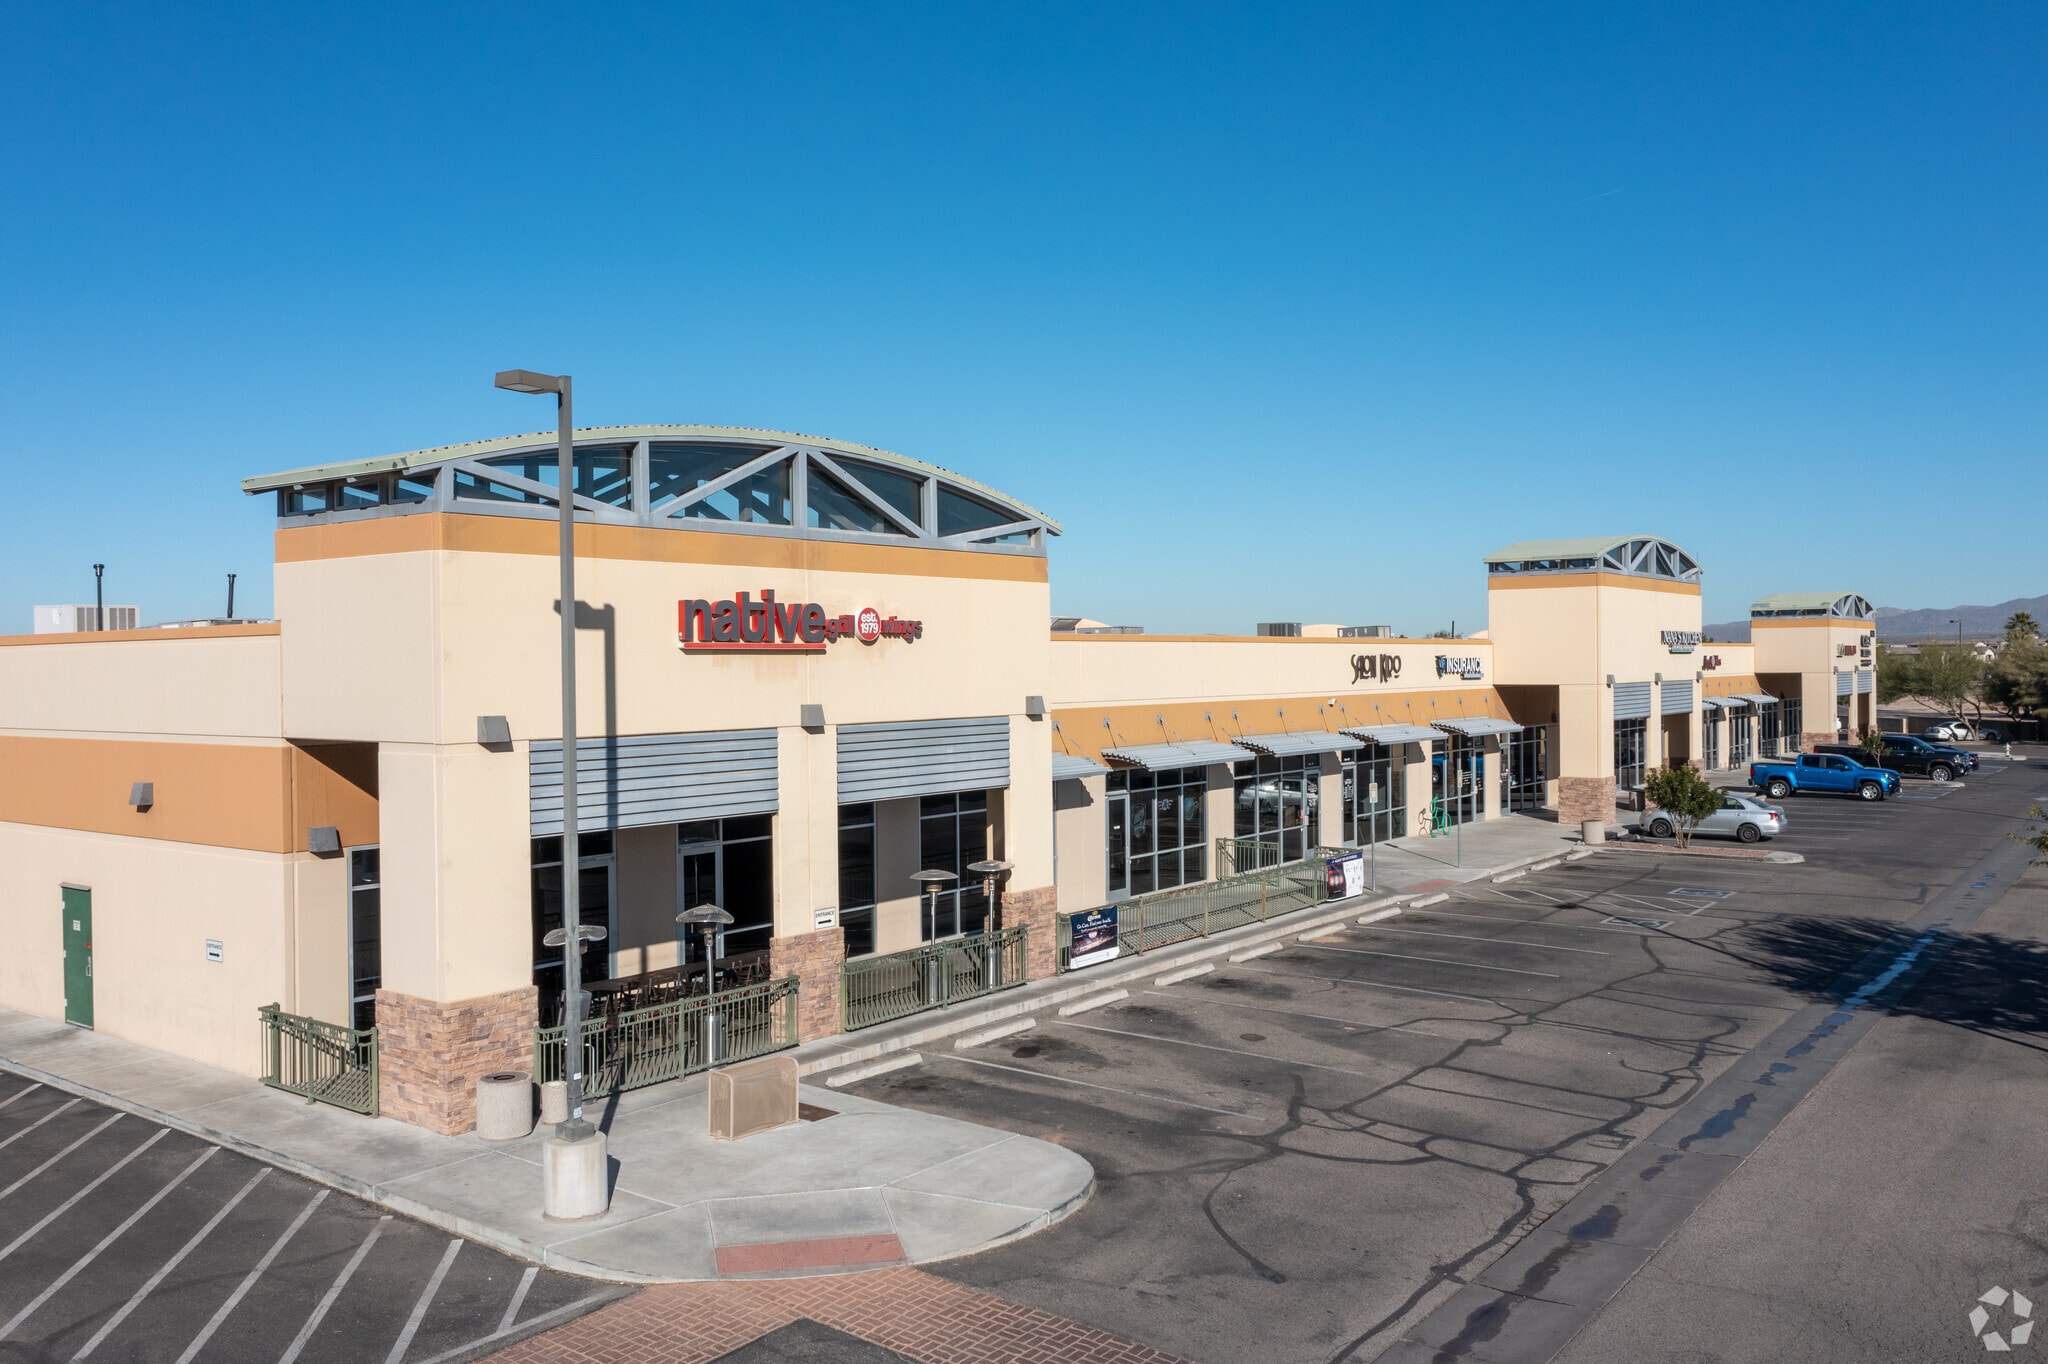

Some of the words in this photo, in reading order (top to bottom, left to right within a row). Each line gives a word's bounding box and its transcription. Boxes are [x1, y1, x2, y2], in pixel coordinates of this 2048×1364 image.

[678, 589, 826, 642] native
[880, 615, 923, 639] wings
[861, 612, 878, 622] est.
[860, 623, 879, 634] 1979
